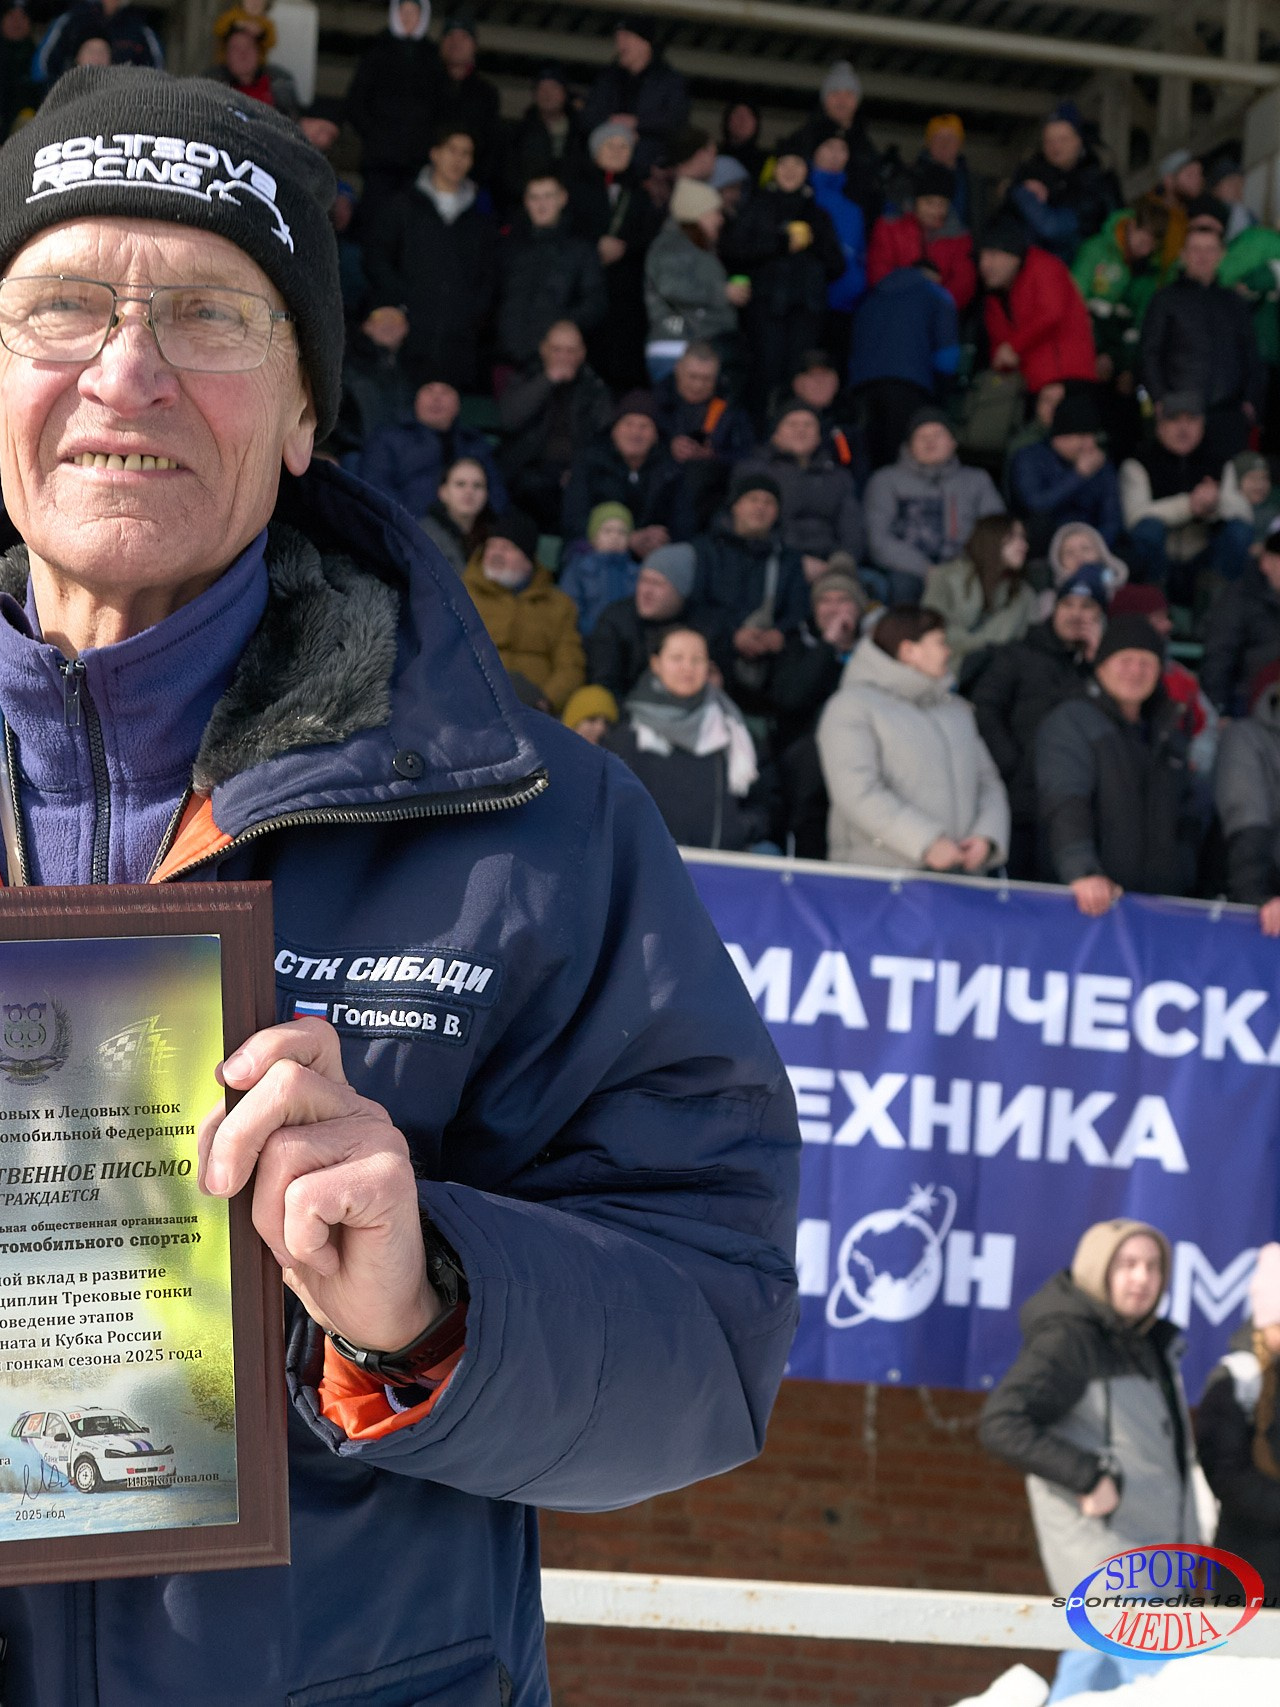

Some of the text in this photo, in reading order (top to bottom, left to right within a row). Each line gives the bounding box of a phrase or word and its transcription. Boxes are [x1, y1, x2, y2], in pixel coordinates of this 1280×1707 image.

[274, 949, 494, 994] СТК СИБАДИ
[332, 1004, 462, 1038] Гольцов В.
[44, 1109, 54, 1119] и
[59, 1104, 130, 1121] Ледовых
[134, 1102, 180, 1115] гонок
[105, 1123, 195, 1142] Федерации
[101, 1160, 192, 1180] ПИСЬМО
[31, 1218, 117, 1233] общественная
[121, 1215, 197, 1229] организация
[130, 1231, 202, 1250] спорта»
[27, 1271, 74, 1286] вклад
[79, 1271, 88, 1282] в
[92, 1266, 166, 1284] развитие
[62, 1289, 141, 1307] Трековые
[145, 1286, 192, 1299] гонки
[80, 1310, 134, 1327] этапов
[41, 1337, 50, 1348] и
[55, 1332, 103, 1347] Кубка
[107, 1329, 162, 1343] России
[6, 1358, 64, 1370] гонкам
[68, 1353, 121, 1366] сезона
[125, 1349, 164, 1364] 2025
[168, 1348, 202, 1362] года
[15, 1510, 65, 1521] 2025 год
